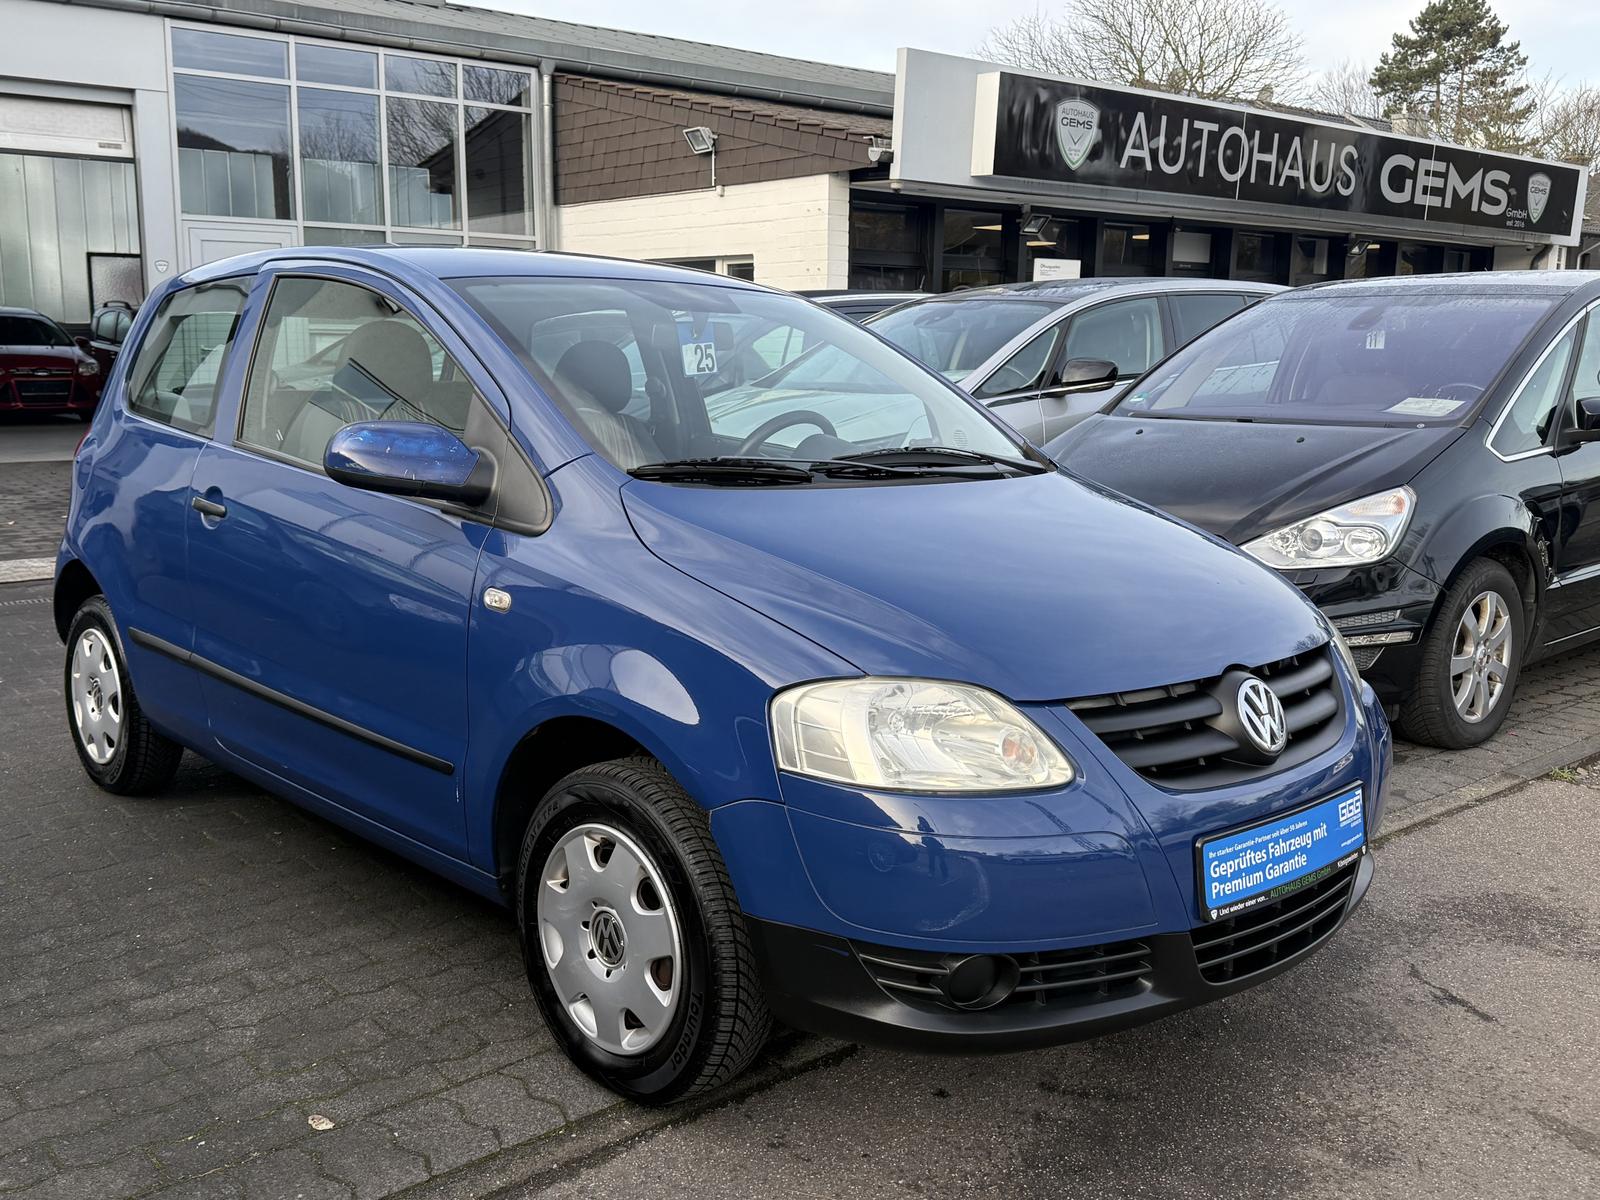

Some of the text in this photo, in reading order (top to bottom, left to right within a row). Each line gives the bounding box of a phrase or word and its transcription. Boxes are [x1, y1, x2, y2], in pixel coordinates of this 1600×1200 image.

[1061, 117, 1093, 130] GEMS
[1062, 107, 1094, 119] AUTOHAUS
[1119, 112, 1511, 216] AUTOHAUS GEMS
[1530, 186, 1547, 195] GEMS
[1506, 207, 1527, 219] GmbH
[694, 344, 715, 372] 25
[1339, 792, 1361, 822] GGG
[1211, 849, 1266, 878] Geprüftes
[1269, 832, 1311, 859] Fahrzeug
[1313, 823, 1327, 842] mit
[1217, 846, 1234, 857] starker
[1234, 834, 1271, 851] Garantie-Partner
[1212, 853, 1306, 899] Premium Garantie
[1219, 906, 1229, 916] Und
[1230, 901, 1244, 913] wieder
[1245, 899, 1256, 907] einer
[1270, 882, 1301, 898] AUTOHAUS
[1301, 874, 1316, 885] GEMS
